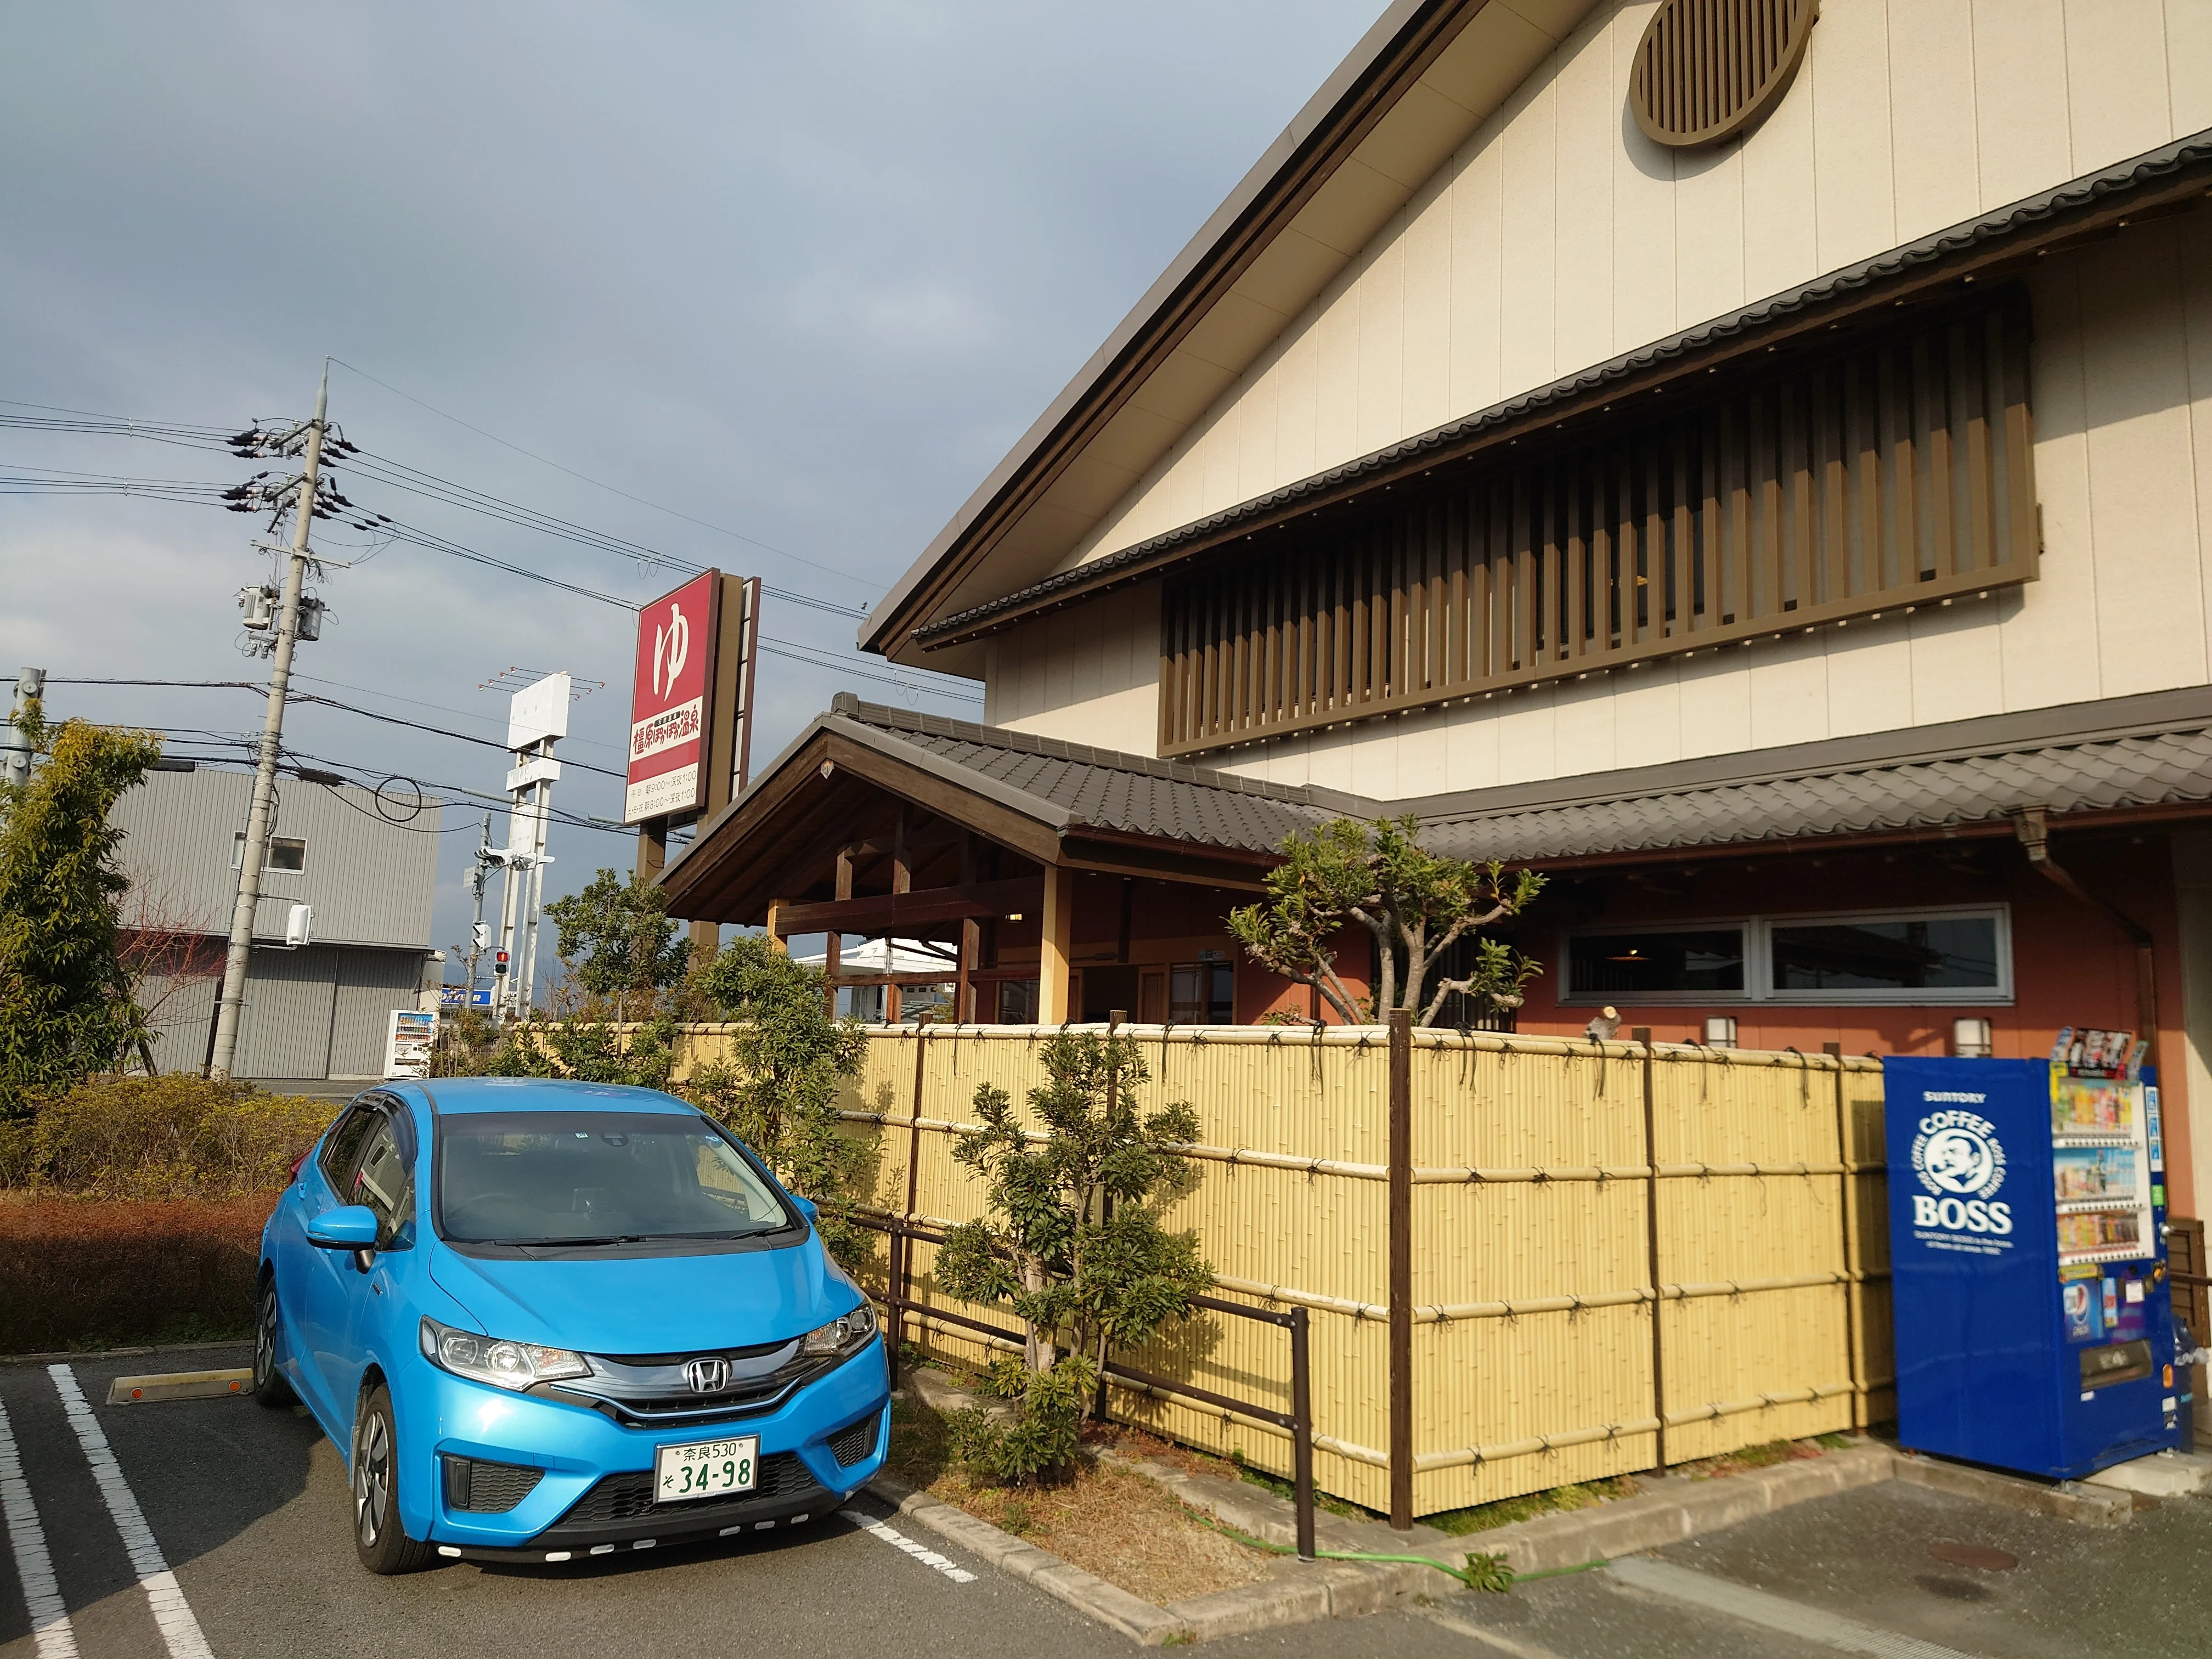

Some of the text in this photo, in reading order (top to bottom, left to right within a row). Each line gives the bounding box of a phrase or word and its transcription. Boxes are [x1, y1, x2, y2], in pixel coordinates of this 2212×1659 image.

[653, 603, 689, 702] ゆ
[1919, 1110, 1996, 1138] COFFEE
[1912, 1195, 2013, 1234] BOSS
[663, 1459, 751, 1493] そ 34-98
